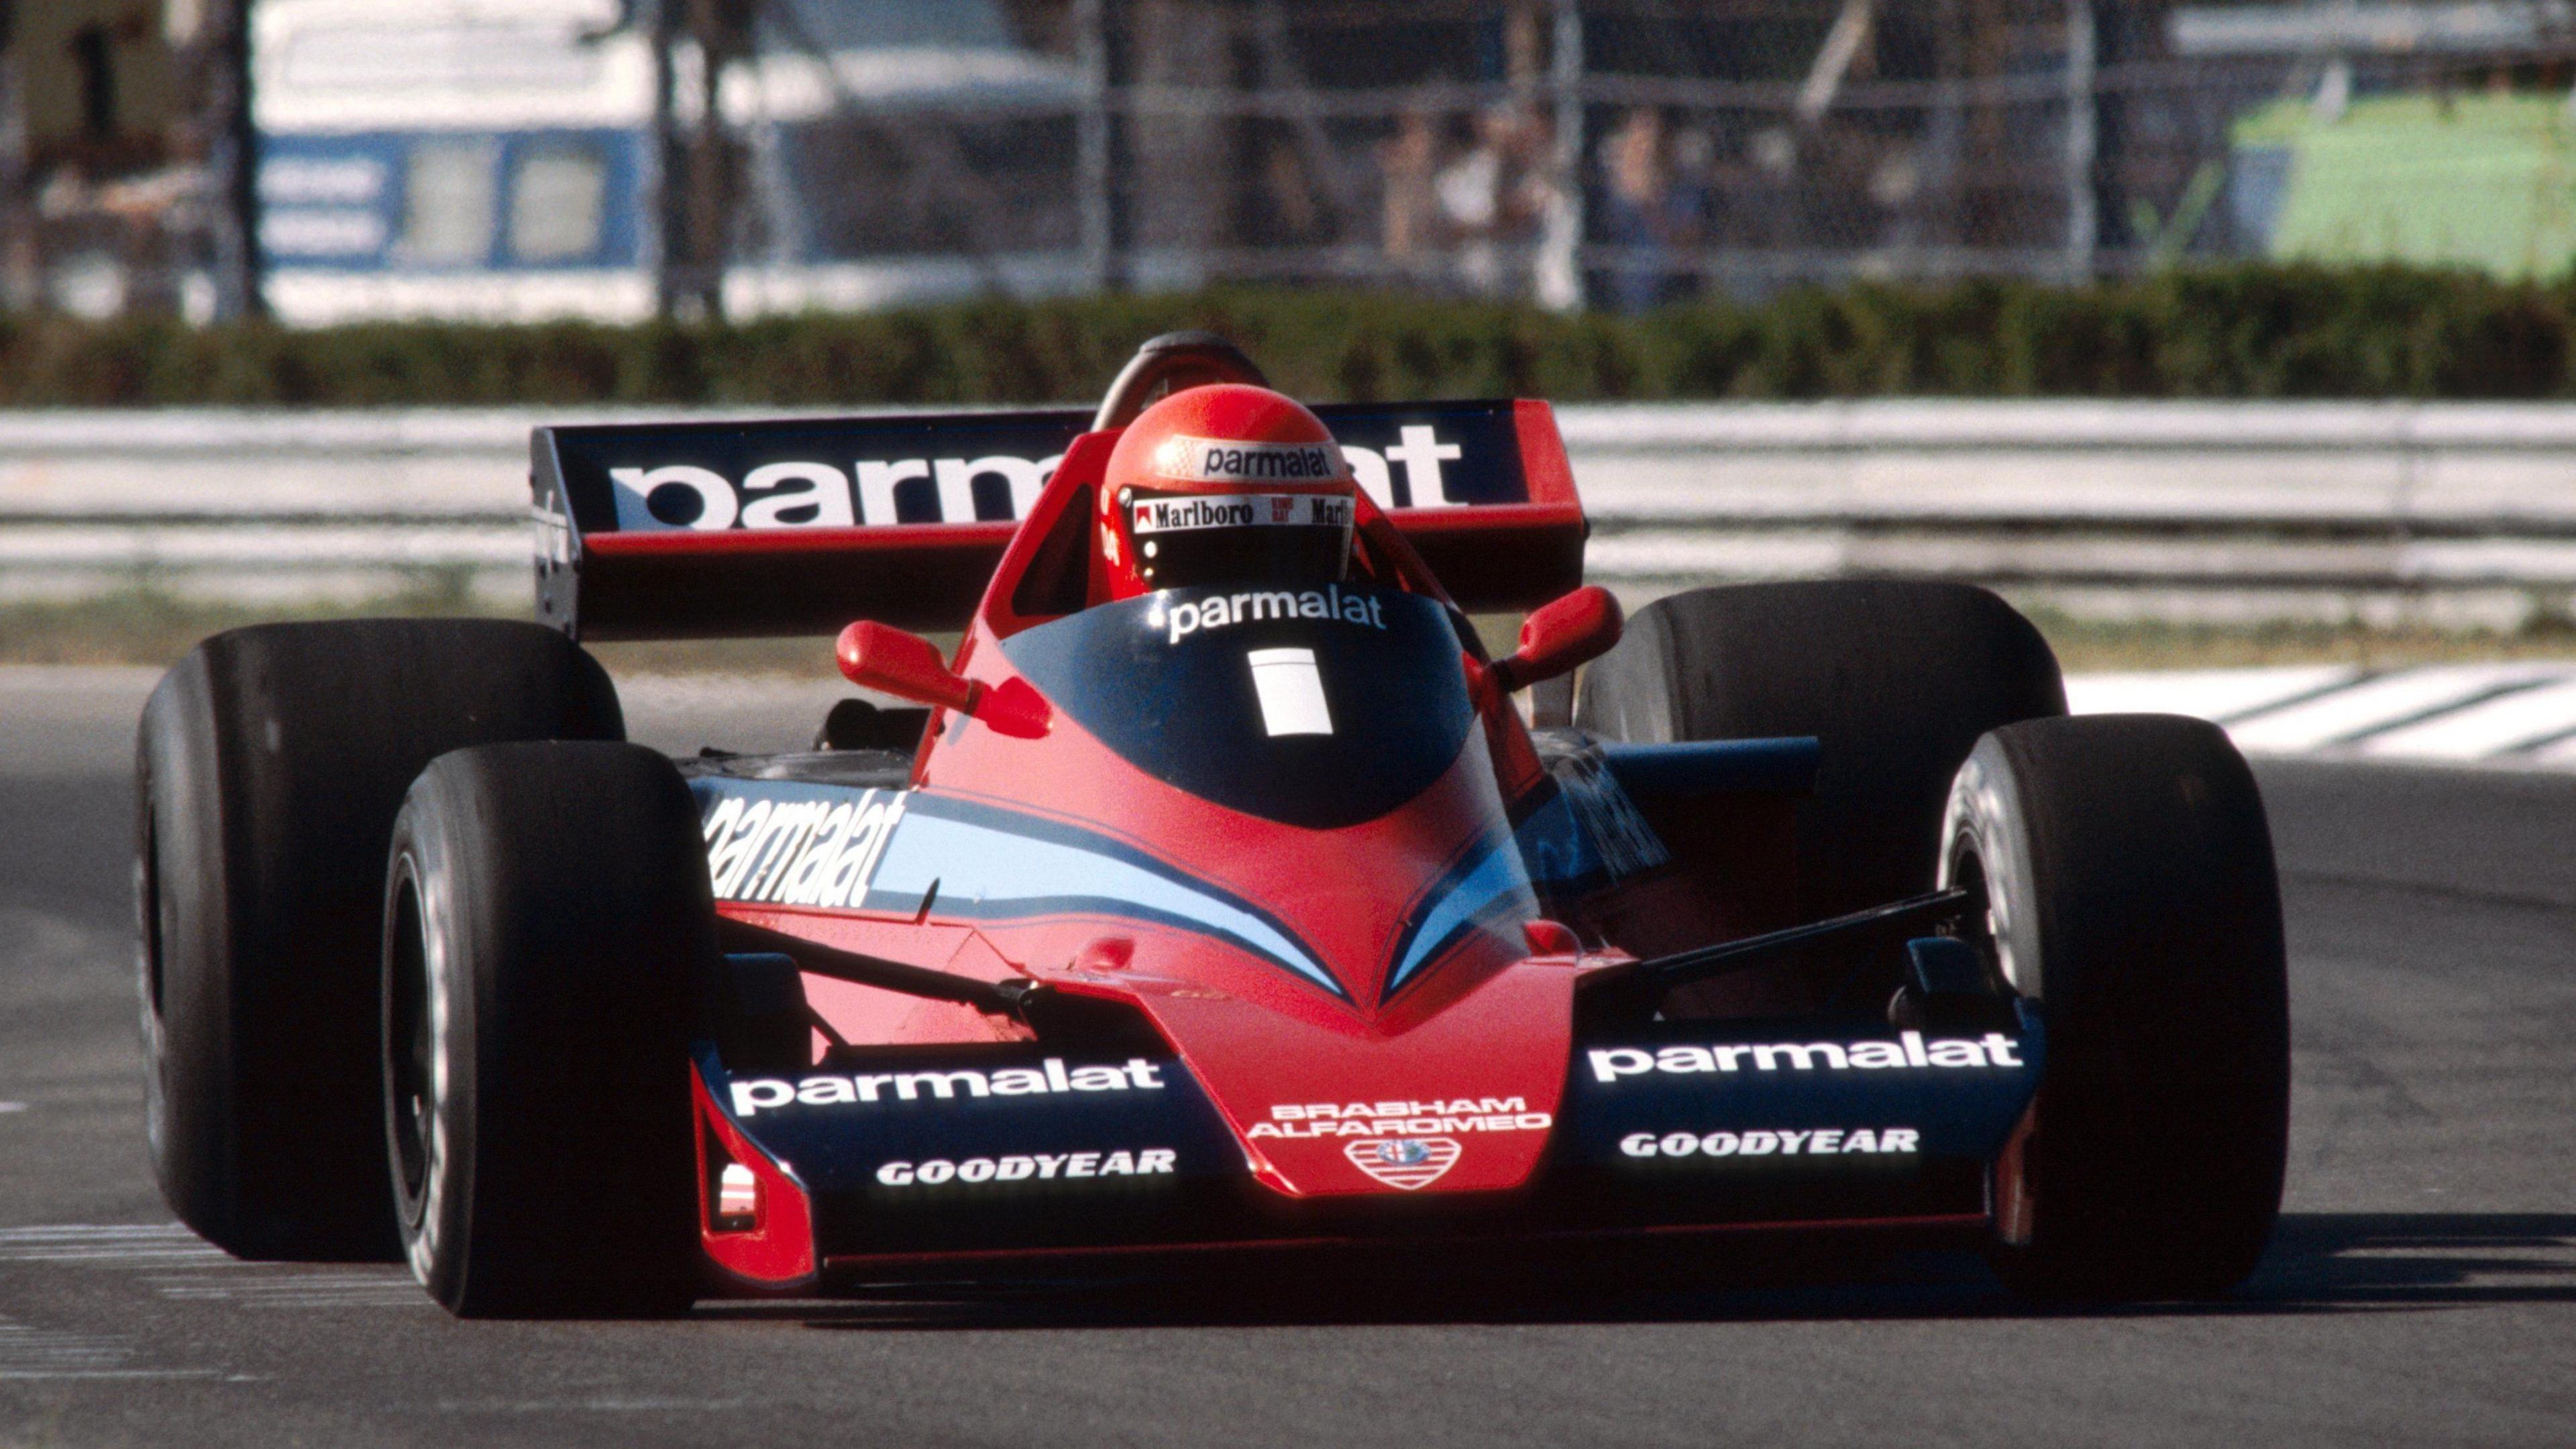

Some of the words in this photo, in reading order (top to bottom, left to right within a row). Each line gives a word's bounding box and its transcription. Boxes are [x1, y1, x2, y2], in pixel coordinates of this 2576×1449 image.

[609, 425, 1467, 530] parmt
[1204, 448, 1330, 476] parmalat
[1156, 502, 1253, 528] Marlboro
[1169, 584, 1387, 645] parmalat
[1588, 1031, 2023, 1081] parmalat
[729, 1059, 1164, 1115] parmalat
[1271, 1097, 1526, 1120] BRABHAM
[1246, 1113, 1552, 1138] ALFAROMEO
[1620, 1129, 1919, 1157] GOODYEAR
[876, 1148, 1175, 1185] GOODYEAR
